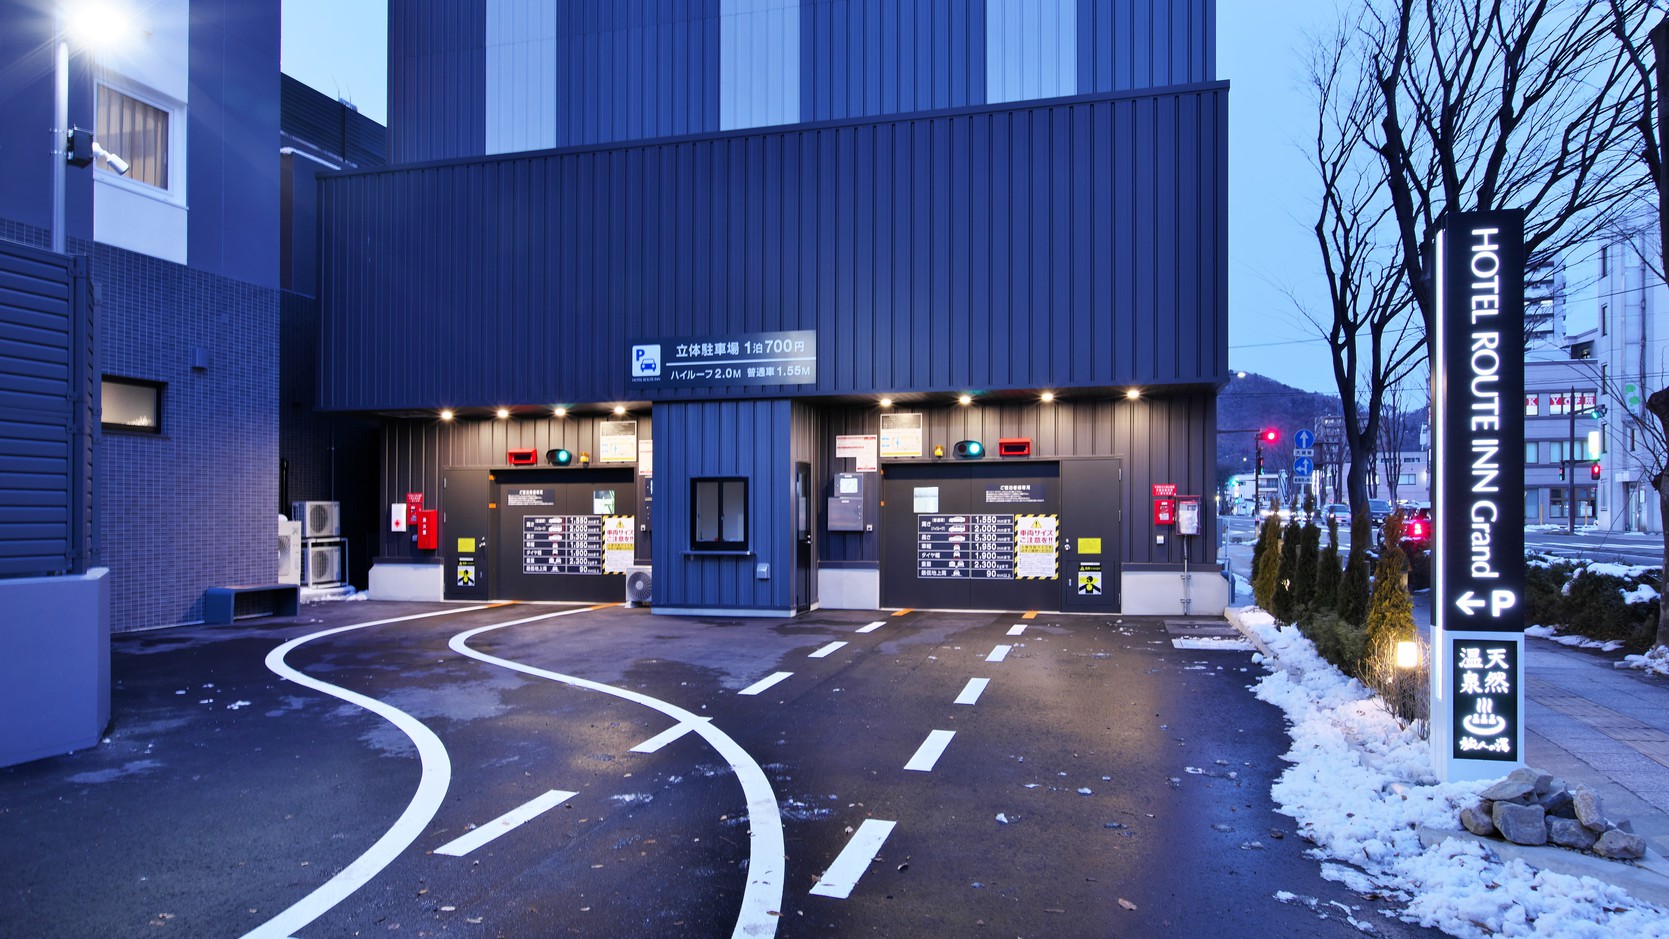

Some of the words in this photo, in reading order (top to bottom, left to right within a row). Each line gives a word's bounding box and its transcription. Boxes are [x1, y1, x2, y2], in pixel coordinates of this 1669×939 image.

[1471, 228, 1499, 325] HOTEL
[636, 349, 645, 361] P
[676, 342, 739, 358] 立体駐車場
[1471, 331, 1499, 431] ROUTE
[1471, 438, 1499, 492] INN
[1471, 500, 1499, 577] Grand
[1490, 589, 1516, 617] P
[1458, 648, 1483, 694] 温泉
[1484, 648, 1510, 694] 天然
